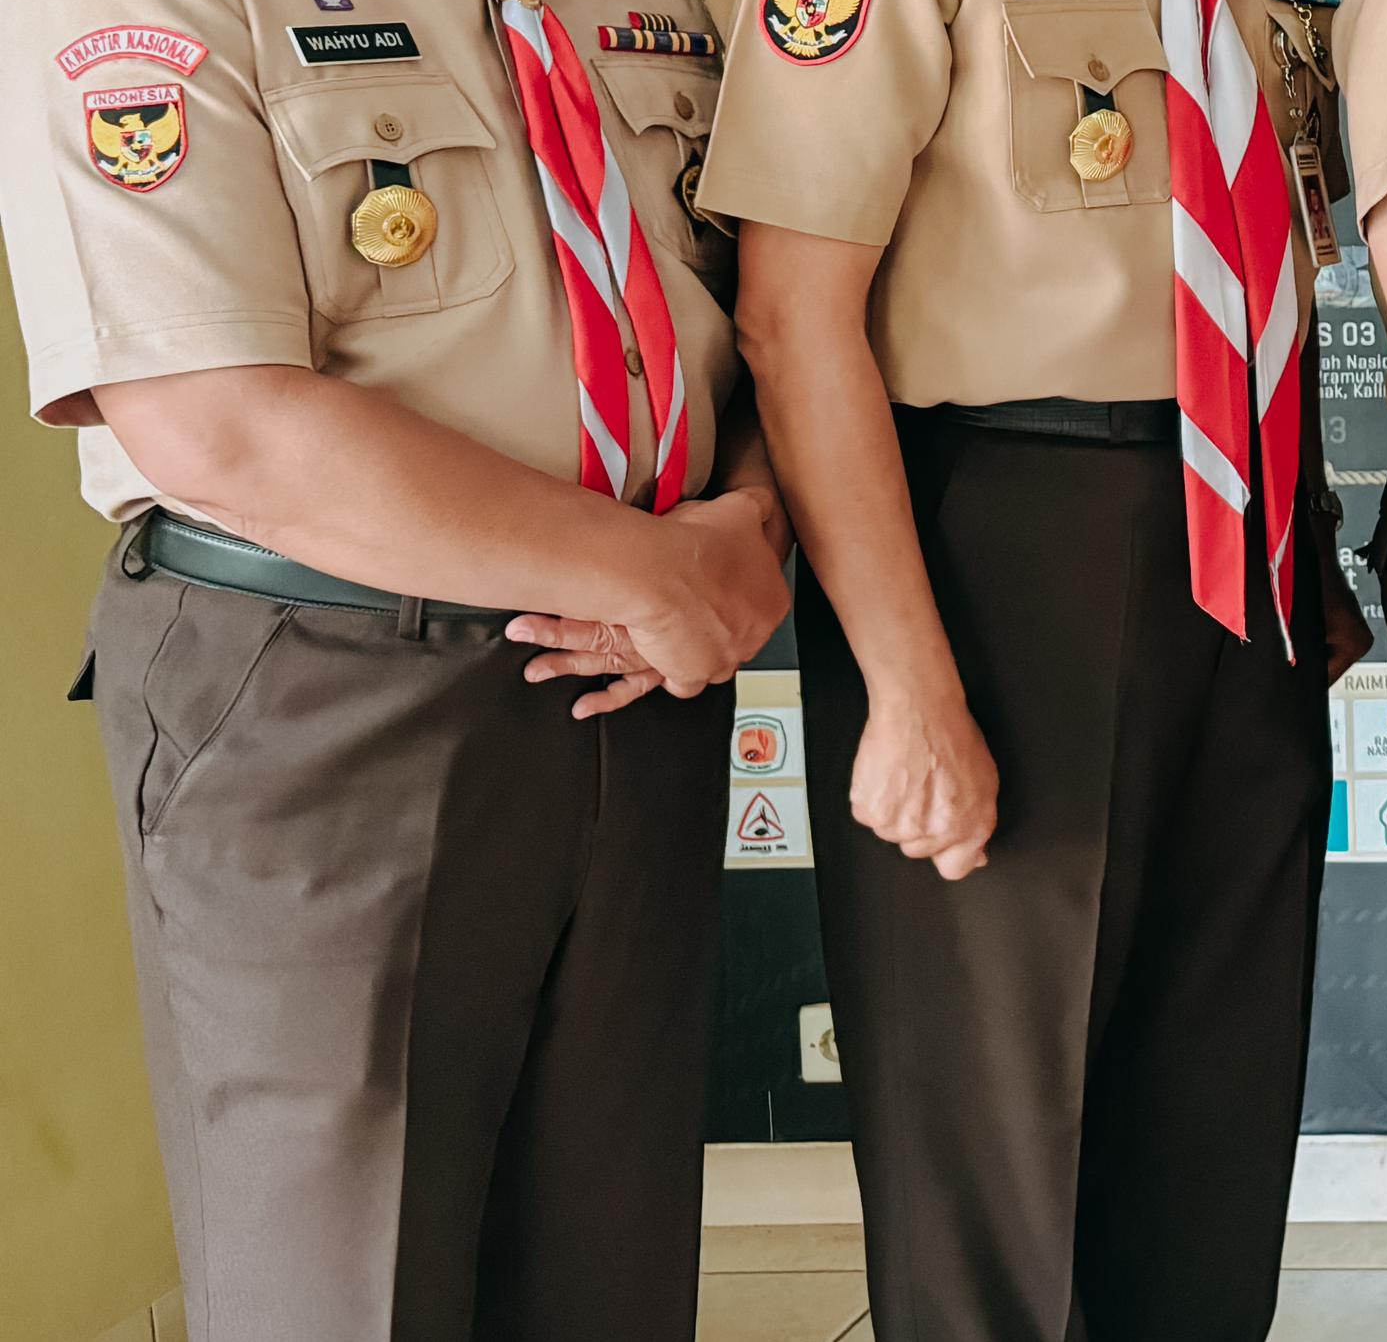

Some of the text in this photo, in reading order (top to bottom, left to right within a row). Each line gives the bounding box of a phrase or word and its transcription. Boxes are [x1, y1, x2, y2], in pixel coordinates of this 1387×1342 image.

[63, 30, 195, 68] KWARTIR NASIONAL
[305, 30, 404, 52] WAHYU ADI
[92, 87, 176, 106] INDONESIA
[1343, 321, 1376, 346] 03
